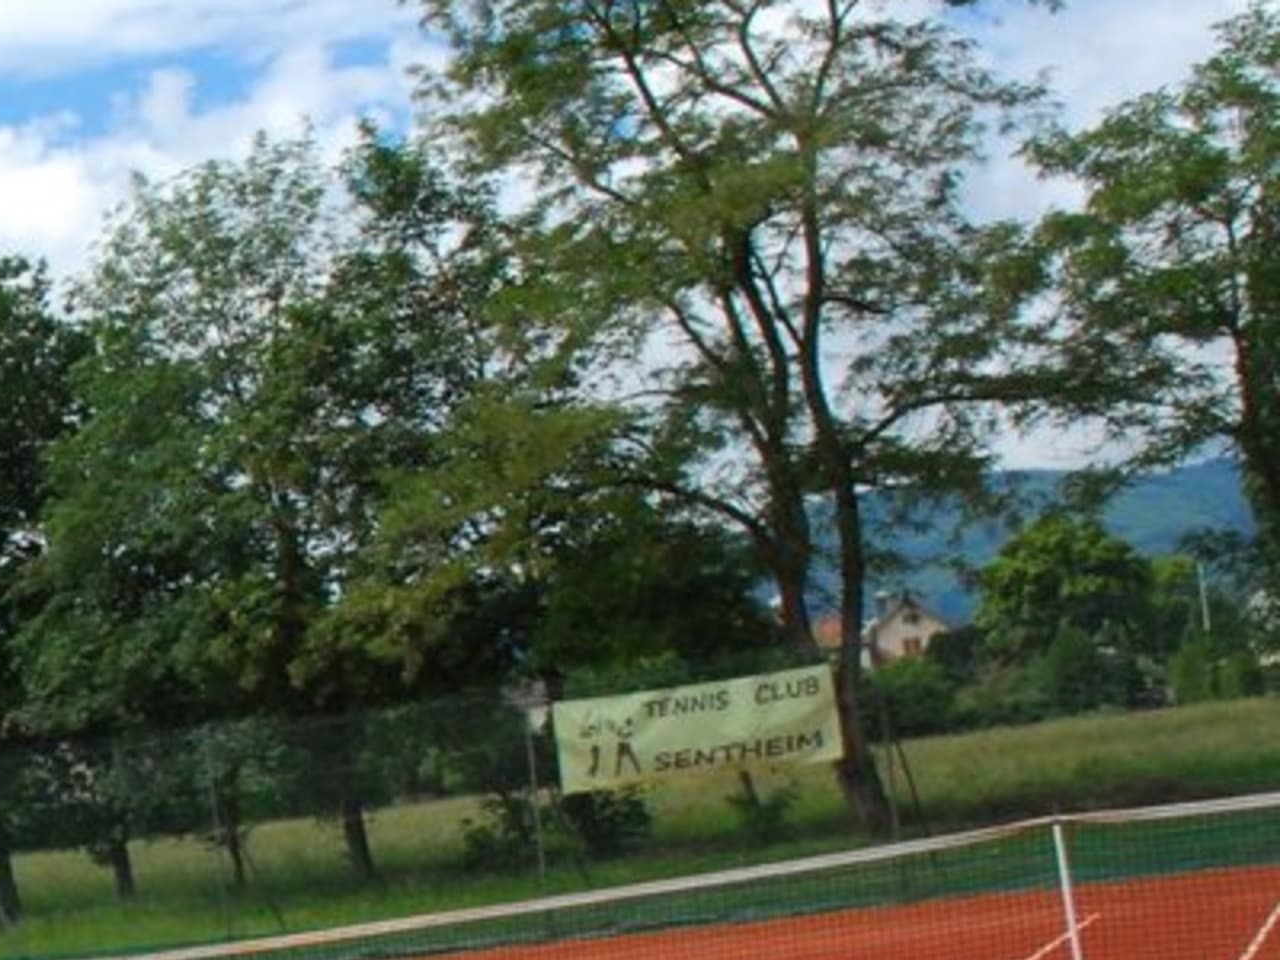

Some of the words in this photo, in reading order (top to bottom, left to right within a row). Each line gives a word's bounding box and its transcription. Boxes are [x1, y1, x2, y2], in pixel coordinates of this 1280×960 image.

[643, 689, 731, 719] TENNIS
[754, 675, 821, 706] CLUB
[652, 728, 824, 773] SENTHEIM
